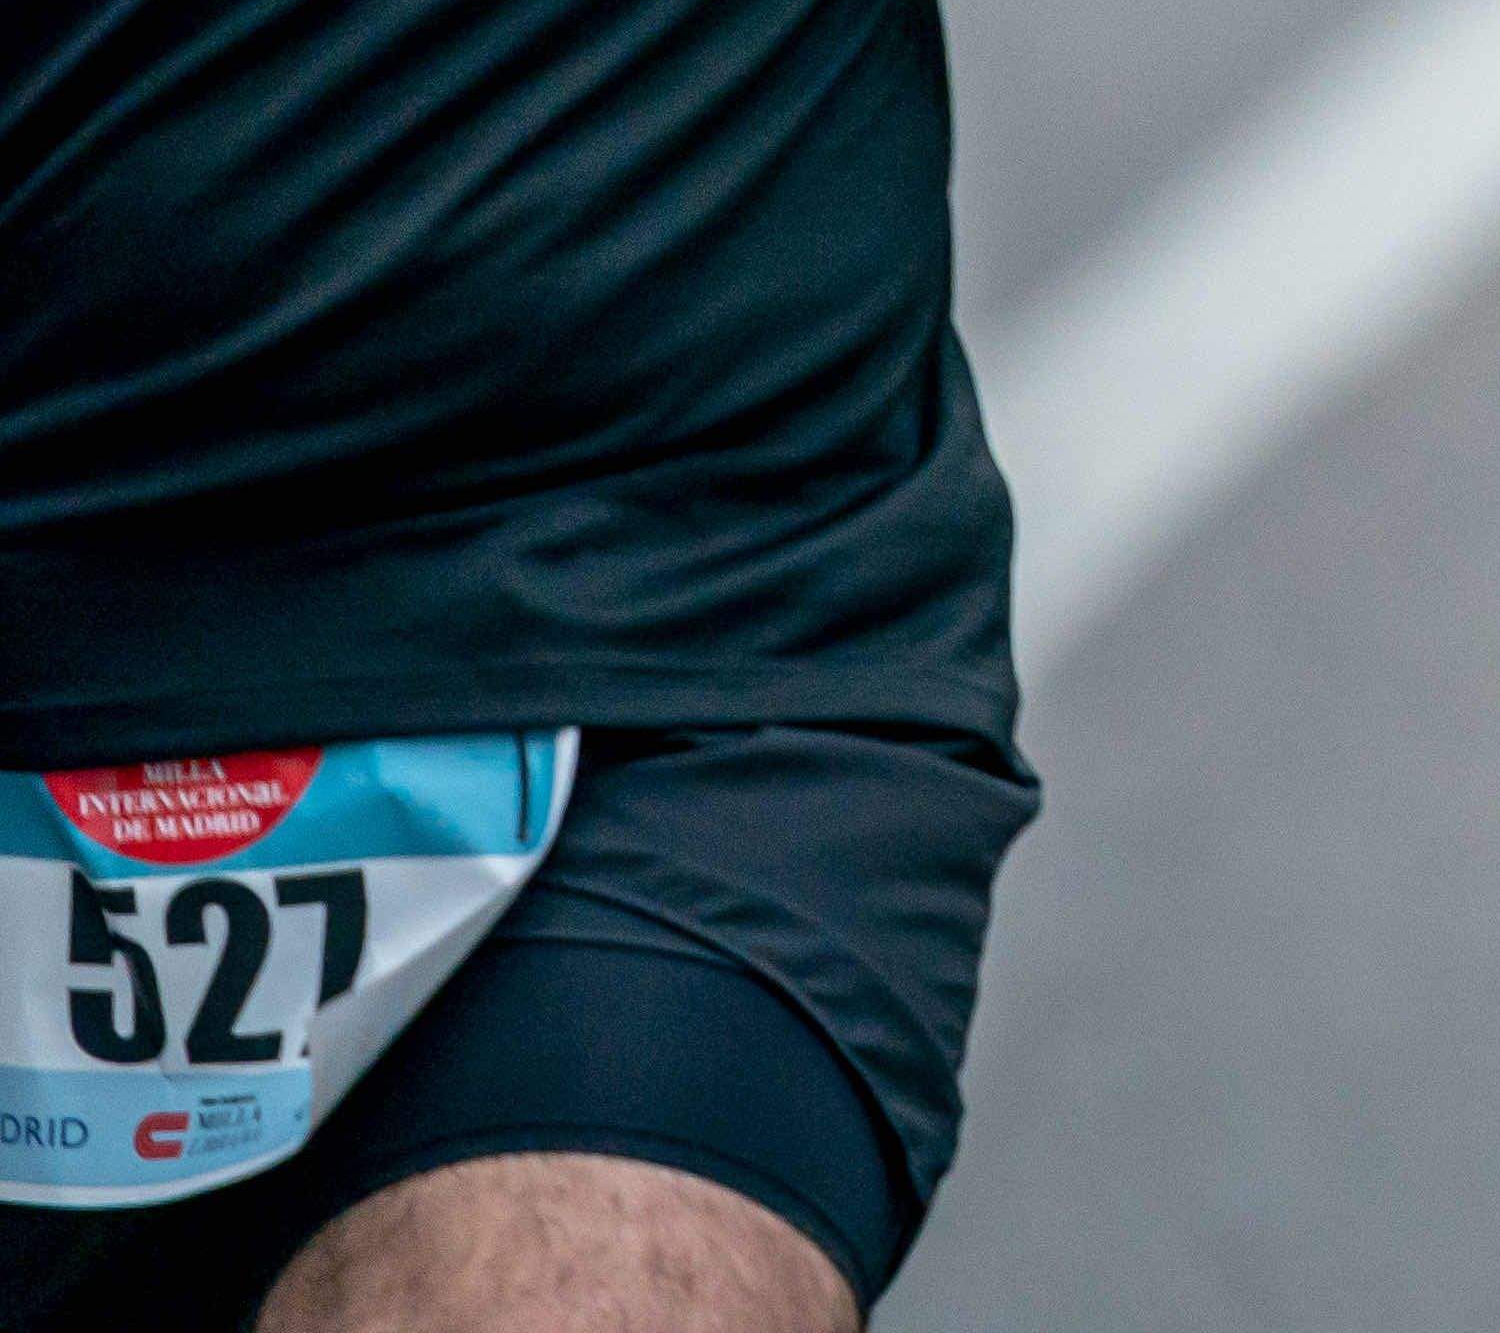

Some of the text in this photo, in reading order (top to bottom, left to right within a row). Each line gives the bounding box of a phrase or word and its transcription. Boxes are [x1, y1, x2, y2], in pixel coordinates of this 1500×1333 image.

[113, 810, 261, 842] DE MADRID
[68, 868, 366, 1064] 527
